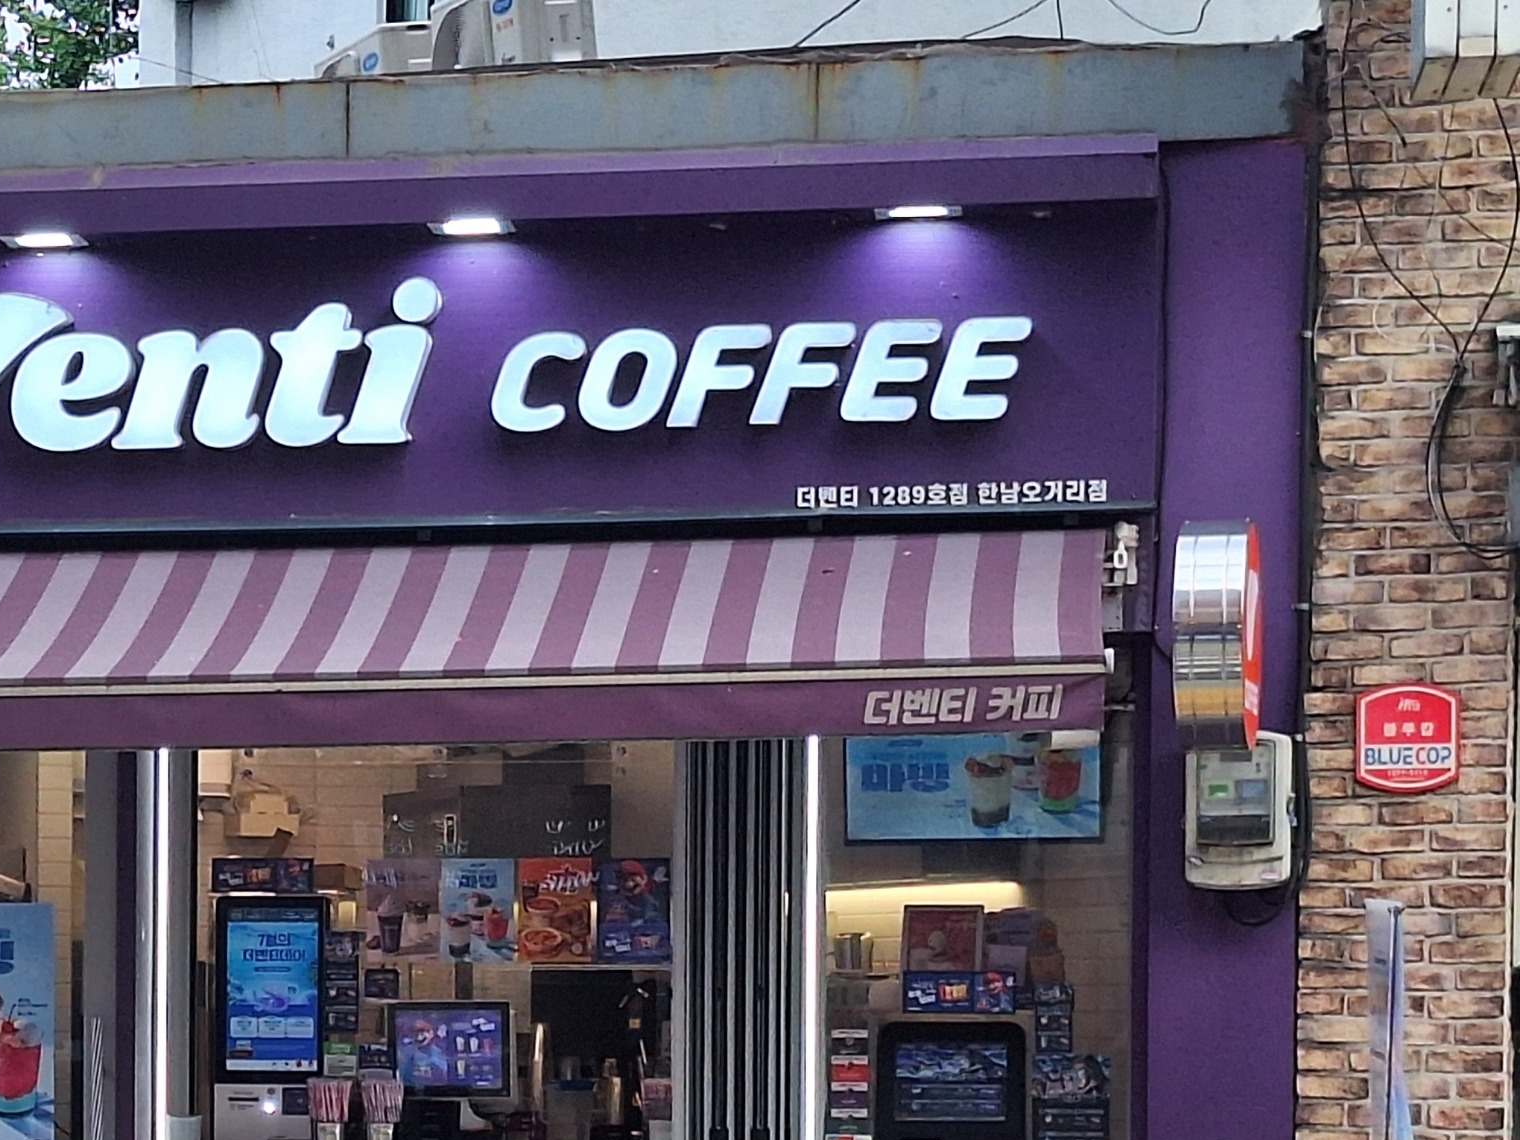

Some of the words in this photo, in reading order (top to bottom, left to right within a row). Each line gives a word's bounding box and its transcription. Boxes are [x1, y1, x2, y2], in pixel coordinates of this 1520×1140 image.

[490, 317, 1033, 432] COFFEE
[796, 485, 858, 508] 더벤티
[868, 483, 968, 506] 1289호점
[977, 479, 1107, 504] 한남오거리점
[864, 687, 977, 725] 더벤티
[986, 684, 1063, 720] 커피
